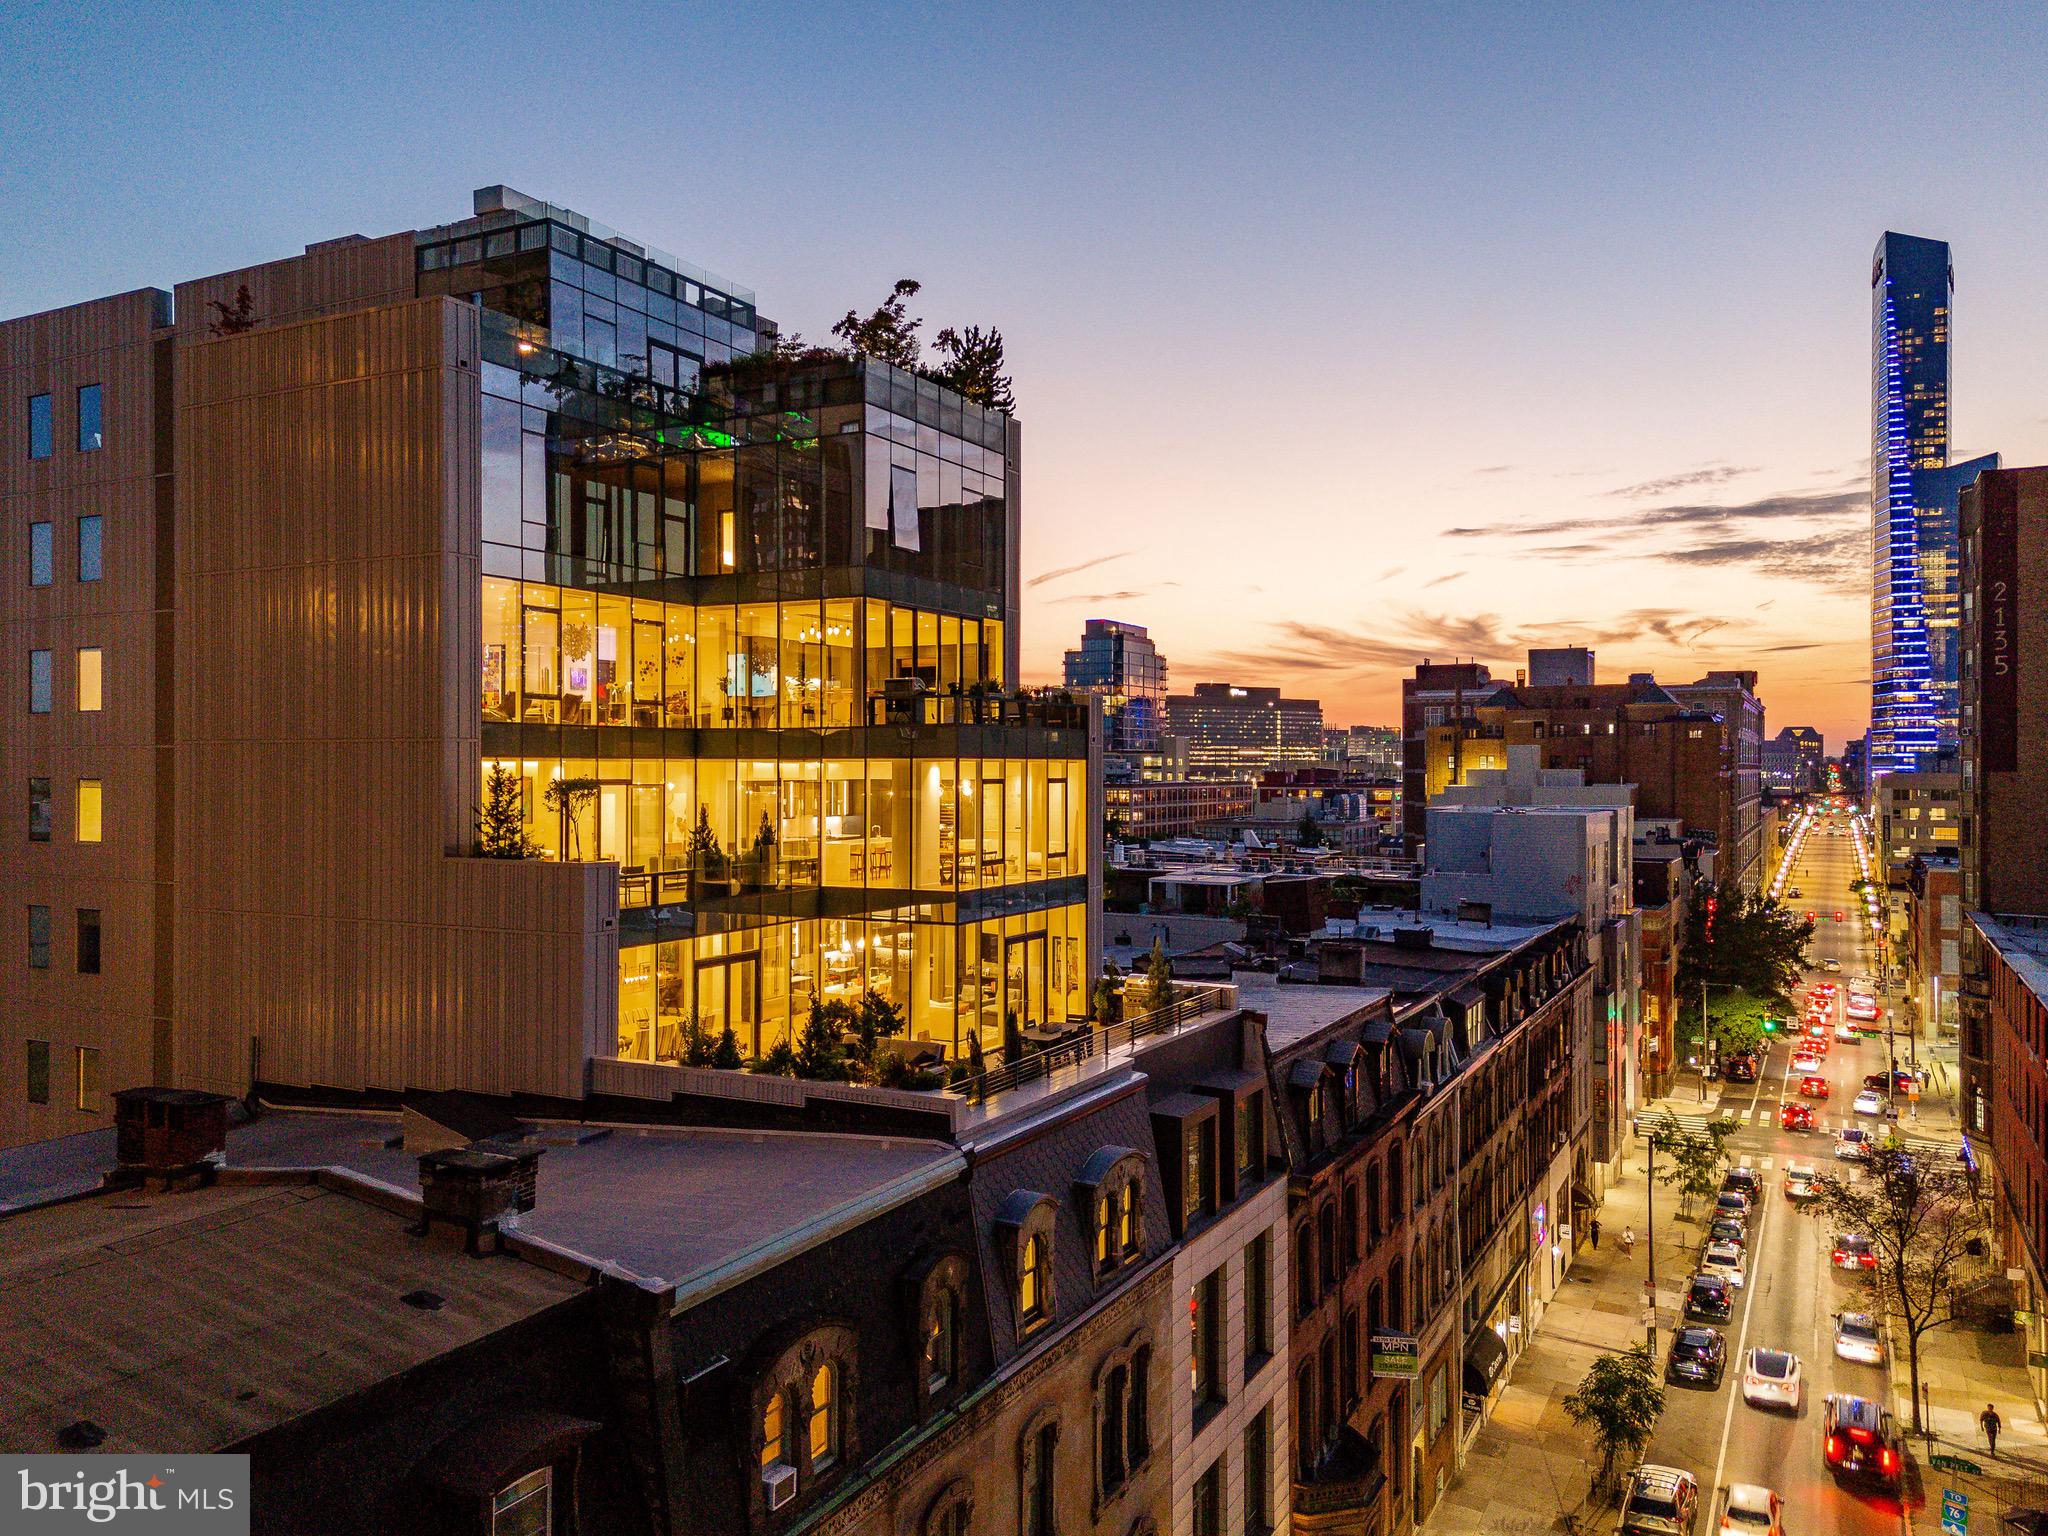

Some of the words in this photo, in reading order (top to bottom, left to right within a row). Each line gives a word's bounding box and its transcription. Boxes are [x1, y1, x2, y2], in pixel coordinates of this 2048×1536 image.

[1993, 581, 2009, 676] 2135
[1381, 1342, 1409, 1352] MPN
[1384, 1356, 1408, 1364] SALE
[1950, 1492, 1962, 1502] TO
[1949, 1507, 1960, 1518] 76
